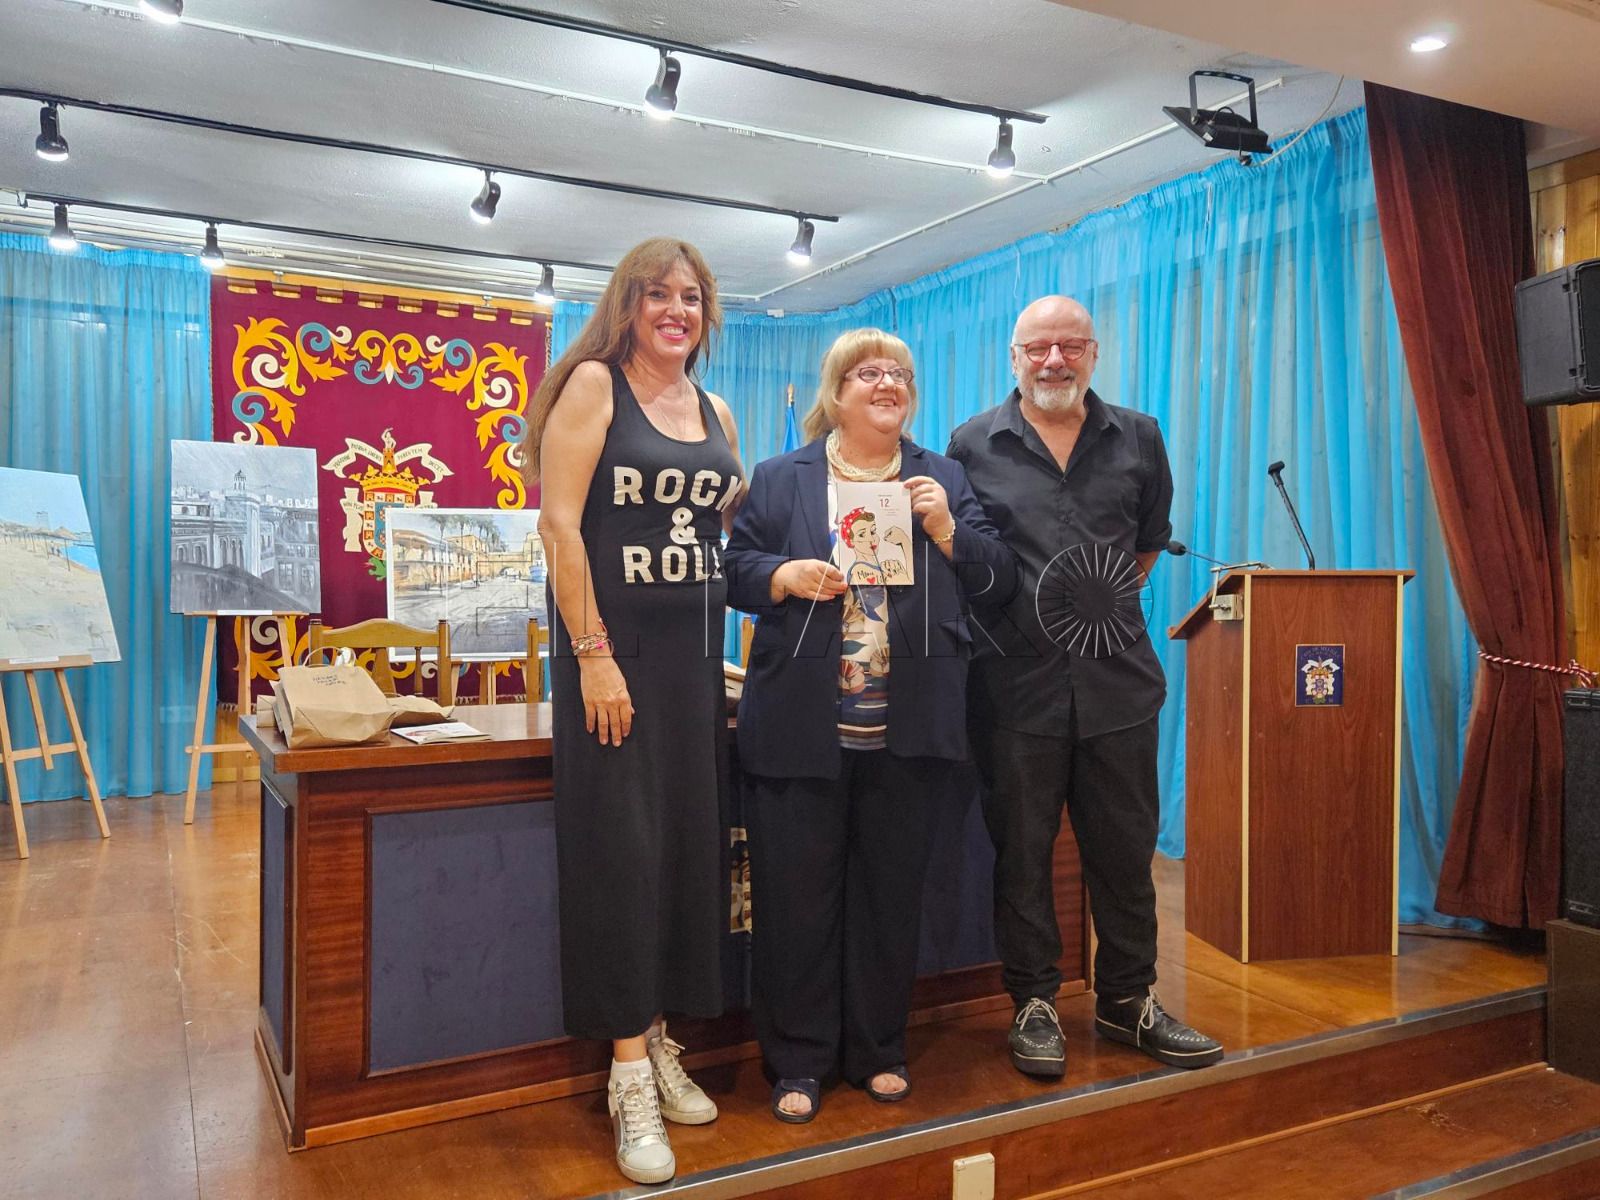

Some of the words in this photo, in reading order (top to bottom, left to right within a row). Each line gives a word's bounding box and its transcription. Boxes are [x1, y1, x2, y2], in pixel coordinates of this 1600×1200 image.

[613, 466, 742, 513] ROCK
[880, 498, 890, 508] 12
[670, 506, 699, 544] &
[622, 545, 723, 583] ROLL
